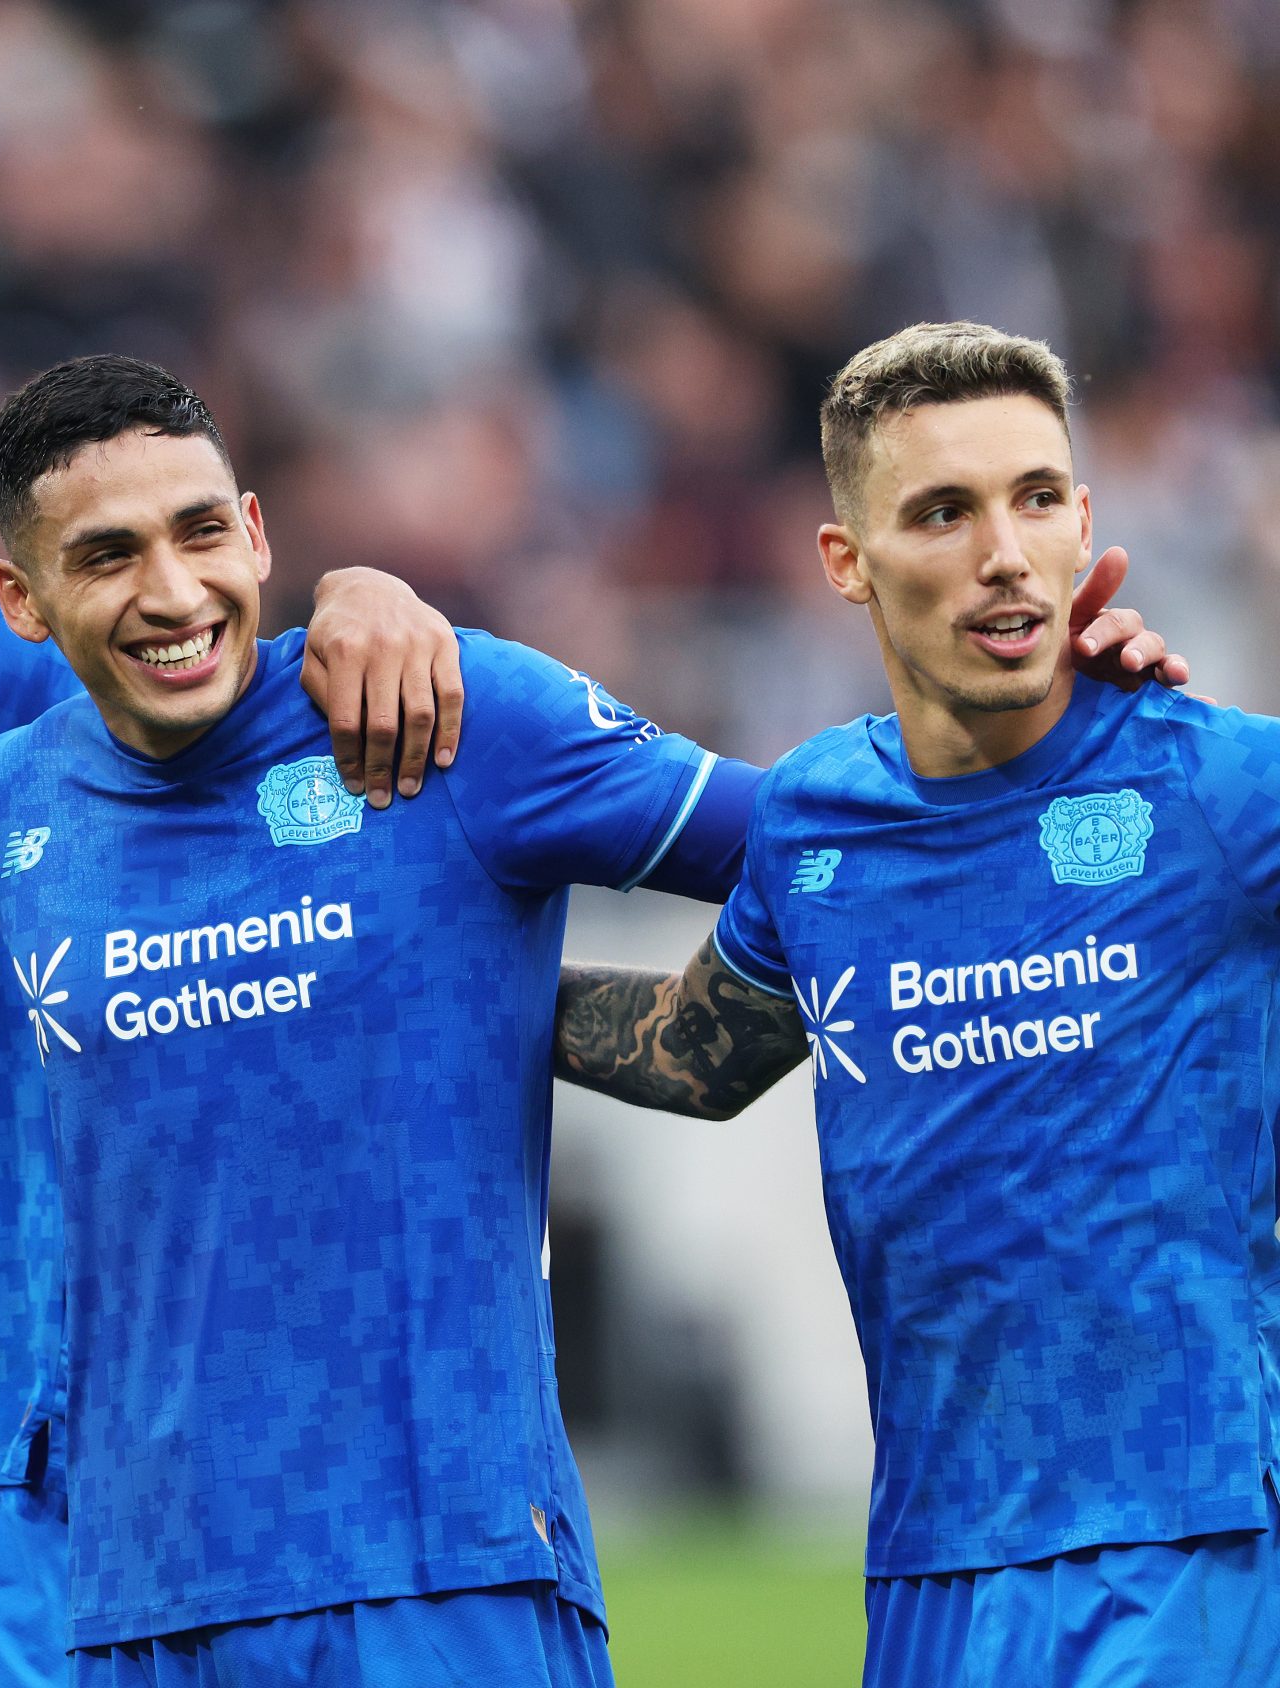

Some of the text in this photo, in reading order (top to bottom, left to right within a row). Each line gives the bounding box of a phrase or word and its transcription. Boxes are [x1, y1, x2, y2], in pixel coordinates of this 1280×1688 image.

[297, 765, 321, 778] 1904
[1081, 801, 1106, 814] 1904
[281, 818, 352, 840] Leverkusen
[1075, 833, 1119, 847] BAYER
[1091, 817, 1102, 863] BAYER
[1063, 860, 1134, 879] Leverkusen
[104, 895, 353, 979] Barmenia
[890, 934, 1138, 1011] Barmenia
[104, 970, 317, 1041] Gothaer
[892, 1011, 1101, 1074] Gothaer
